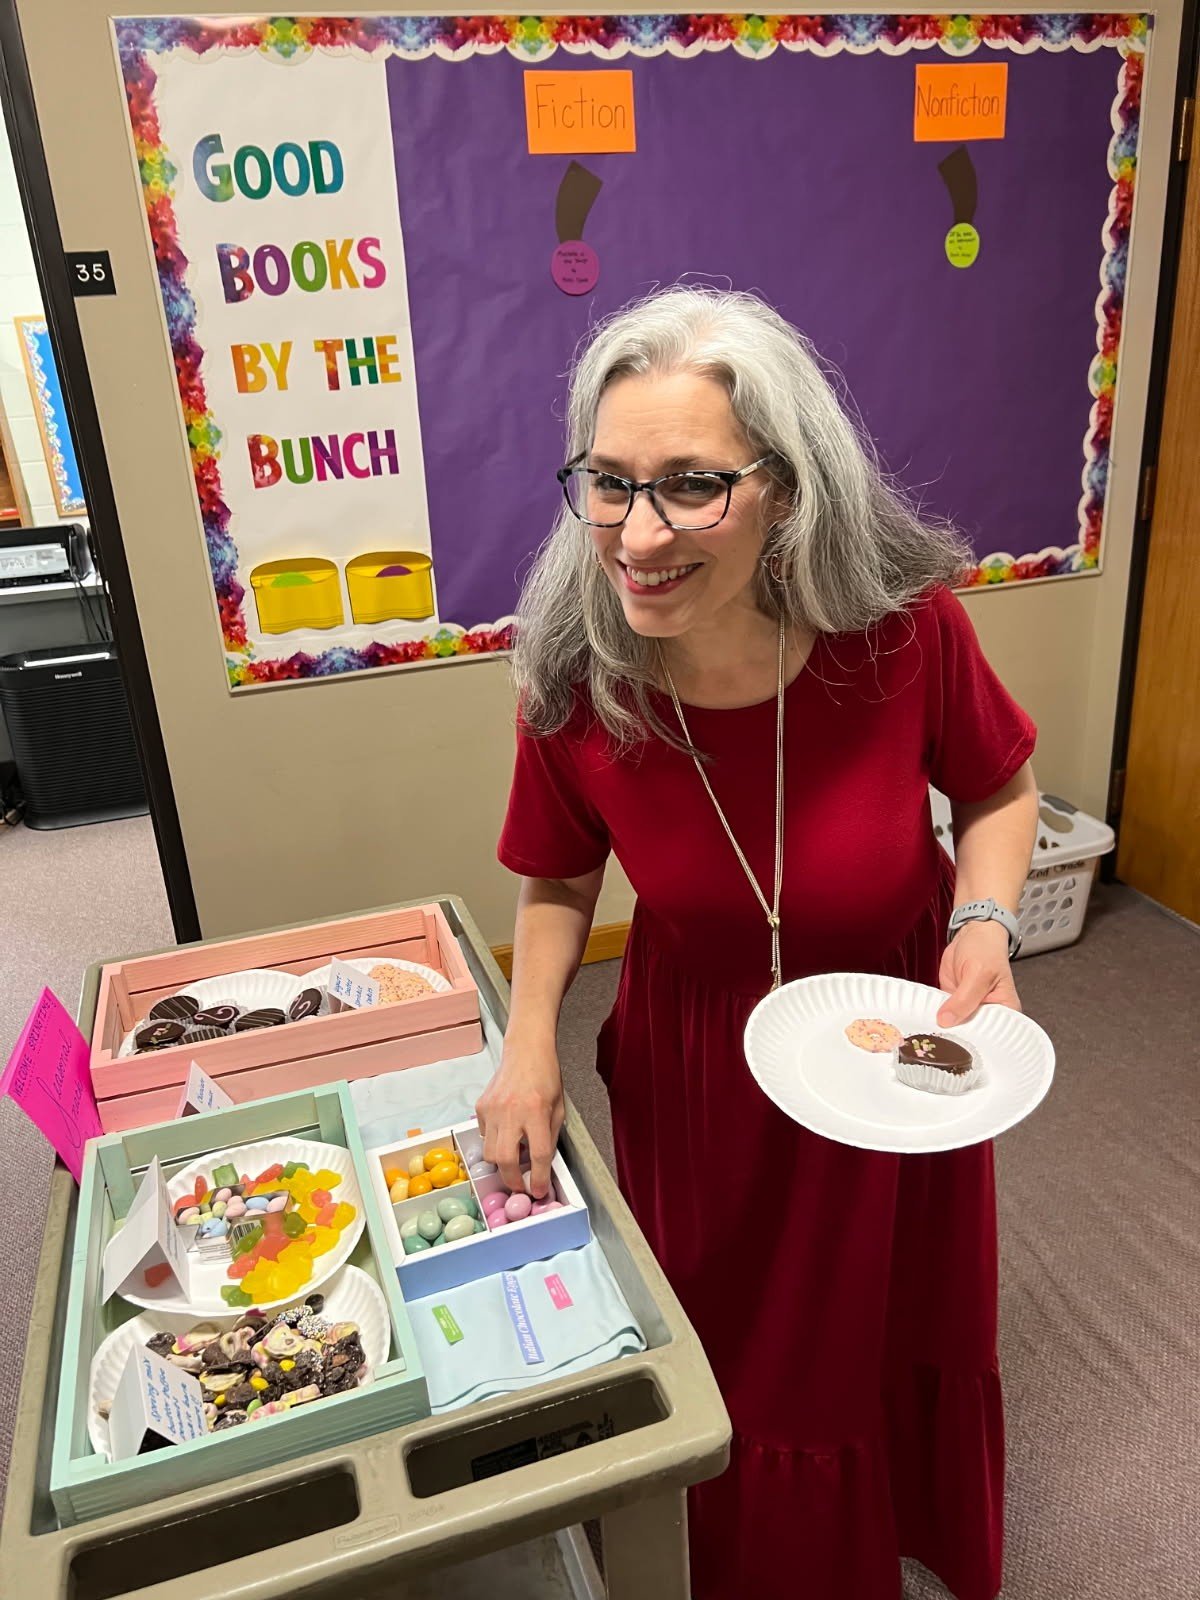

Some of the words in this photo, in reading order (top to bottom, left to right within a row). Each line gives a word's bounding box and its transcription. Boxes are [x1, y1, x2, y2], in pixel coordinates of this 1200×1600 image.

[535, 83, 626, 129] Fiction
[916, 82, 1000, 118] Nonfiction
[192, 133, 345, 203] GOOD
[75, 263, 106, 282] 35
[215, 237, 387, 304] BOOKS
[230, 340, 293, 394] BY
[313, 335, 402, 391] THE
[247, 429, 400, 489] BUNCH
[14, 1054, 34, 1098] WELCOME
